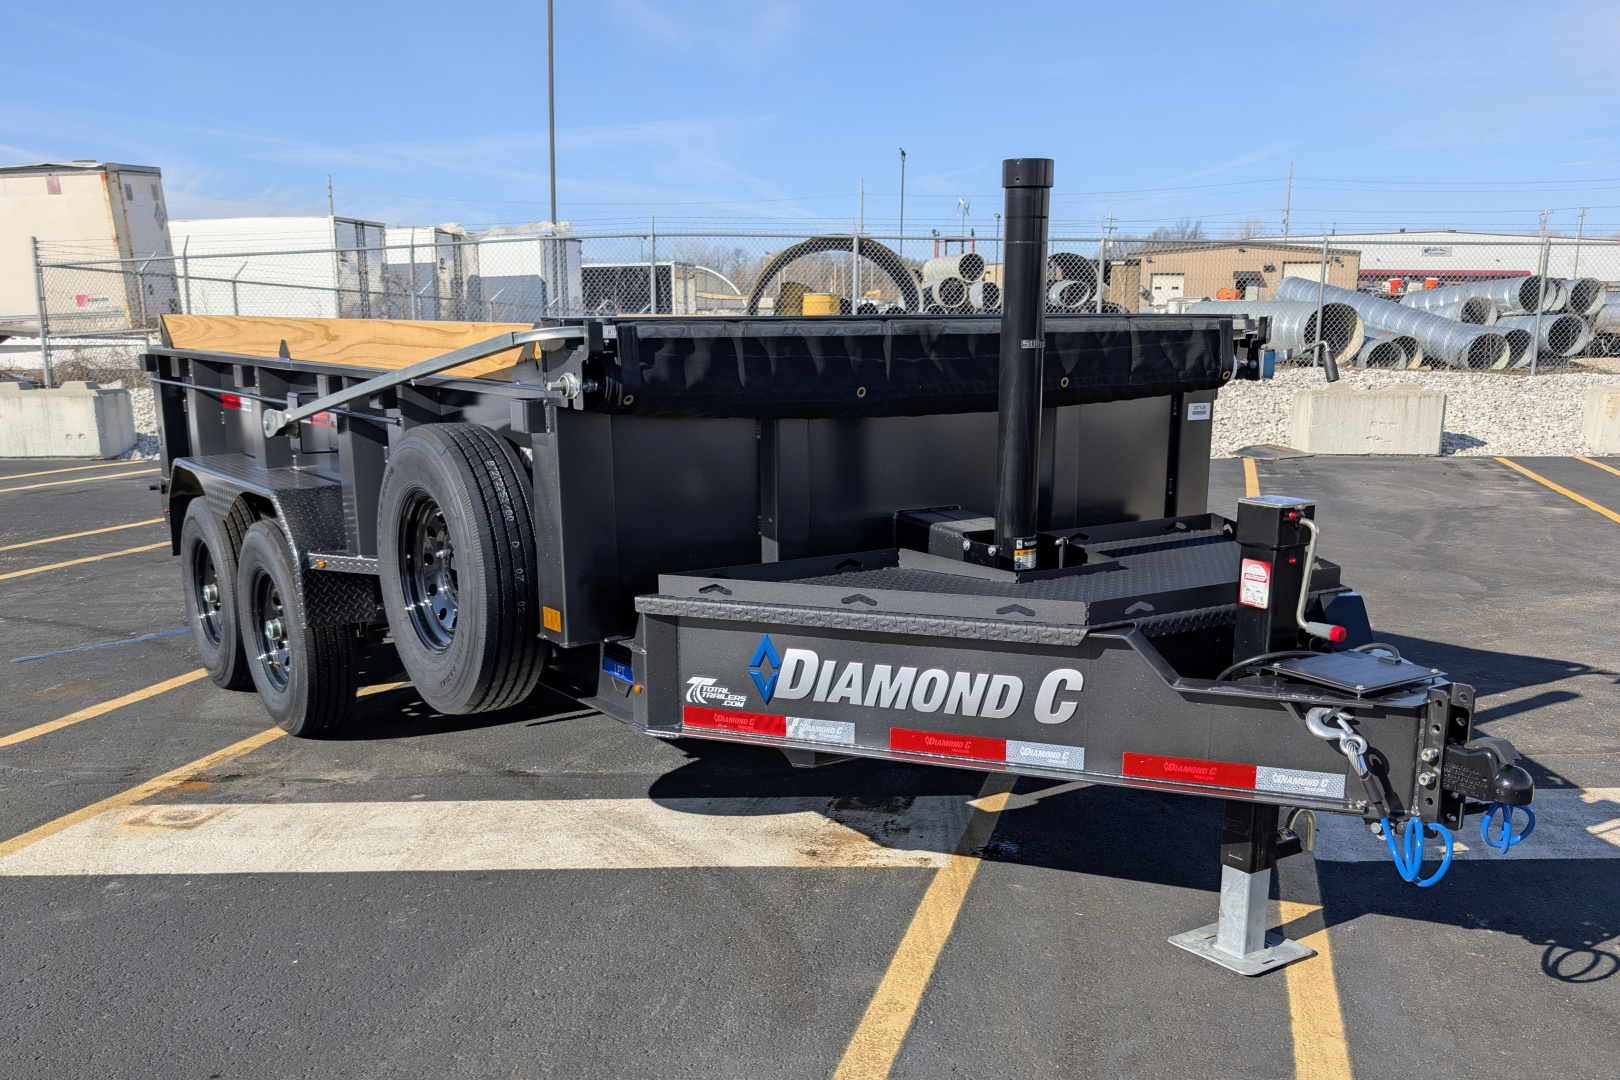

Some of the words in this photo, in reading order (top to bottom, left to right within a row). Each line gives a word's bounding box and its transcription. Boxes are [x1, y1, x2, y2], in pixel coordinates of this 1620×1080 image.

[613, 664, 626, 677] LPT
[702, 686, 730, 694] TOTAL
[702, 692, 748, 702] TRAILERS
[1034, 669, 1084, 724] C
[722, 700, 745, 708] .COM
[964, 741, 971, 749] C
[1209, 767, 1217, 775] C
[1320, 779, 1329, 788] C
